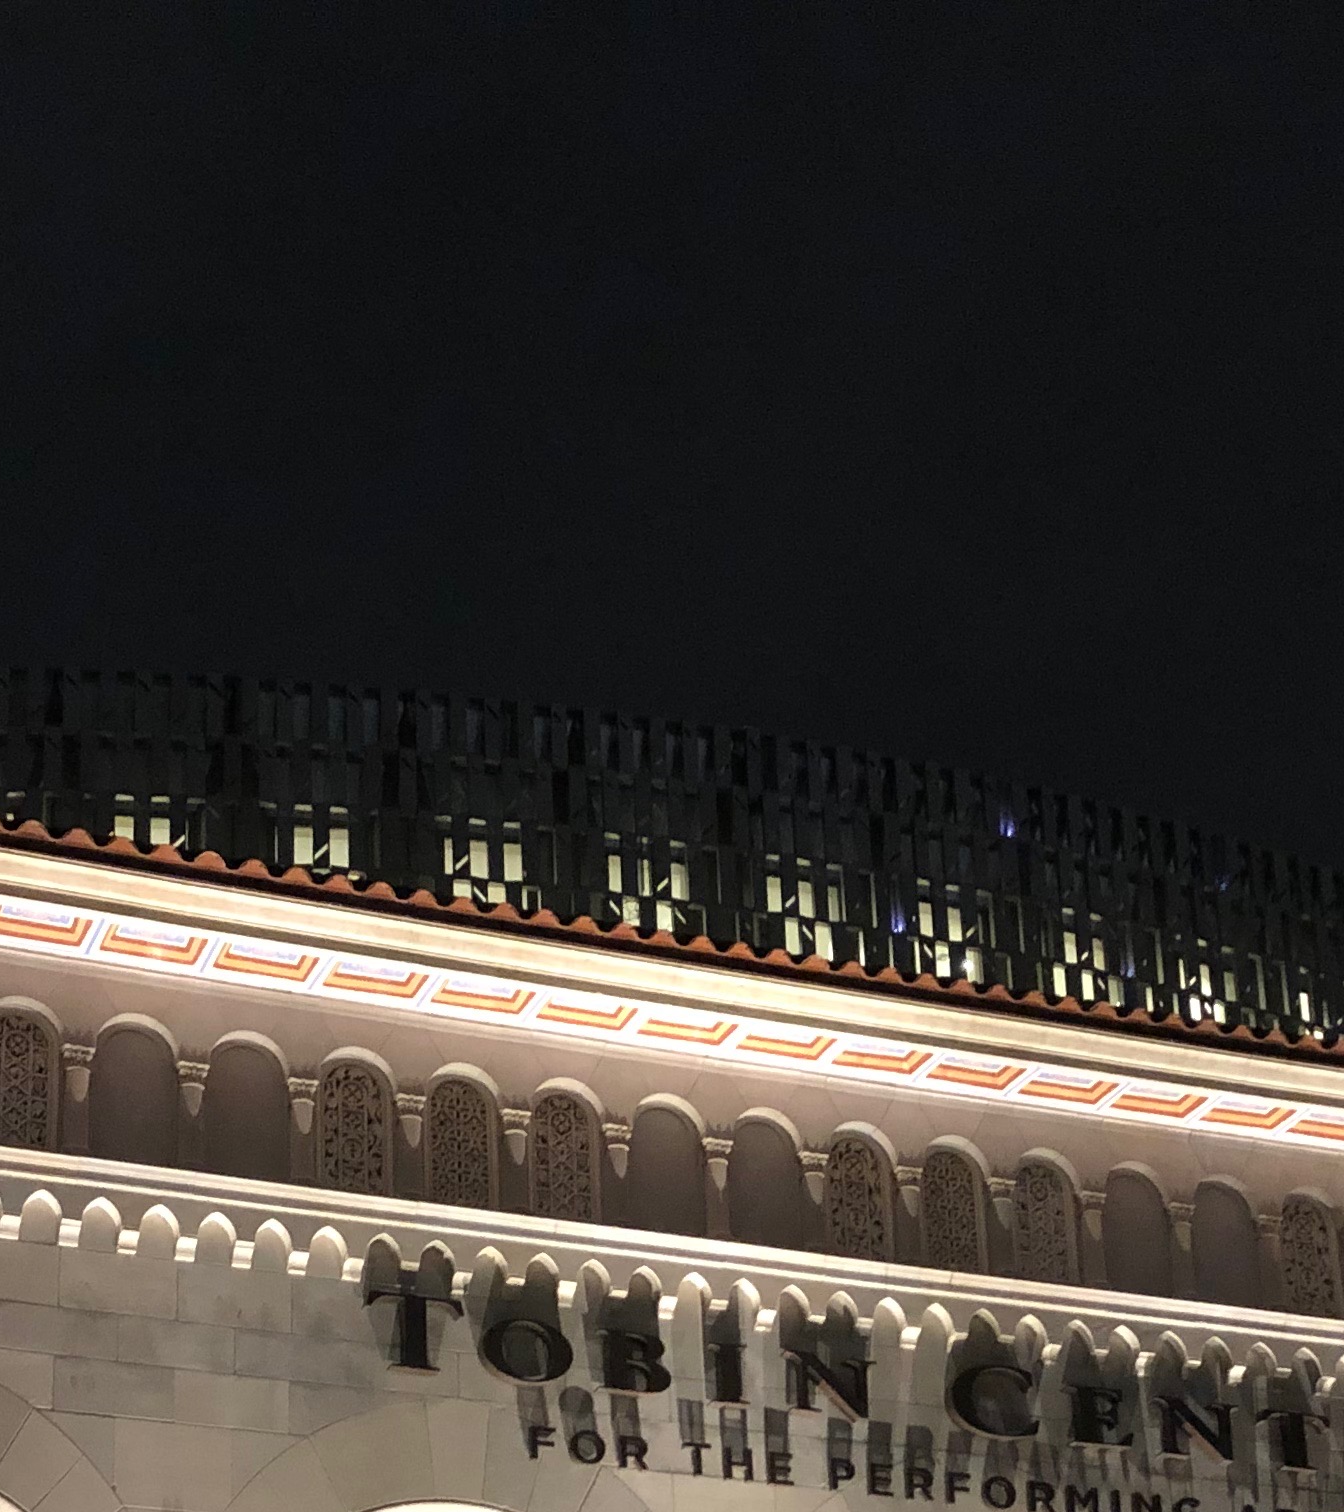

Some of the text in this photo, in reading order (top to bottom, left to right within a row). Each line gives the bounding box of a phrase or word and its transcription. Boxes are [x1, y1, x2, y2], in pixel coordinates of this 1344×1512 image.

[362, 1289, 878, 1423] TOBIN
[529, 1425, 649, 1471] FOR
[681, 1442, 795, 1487] THE
